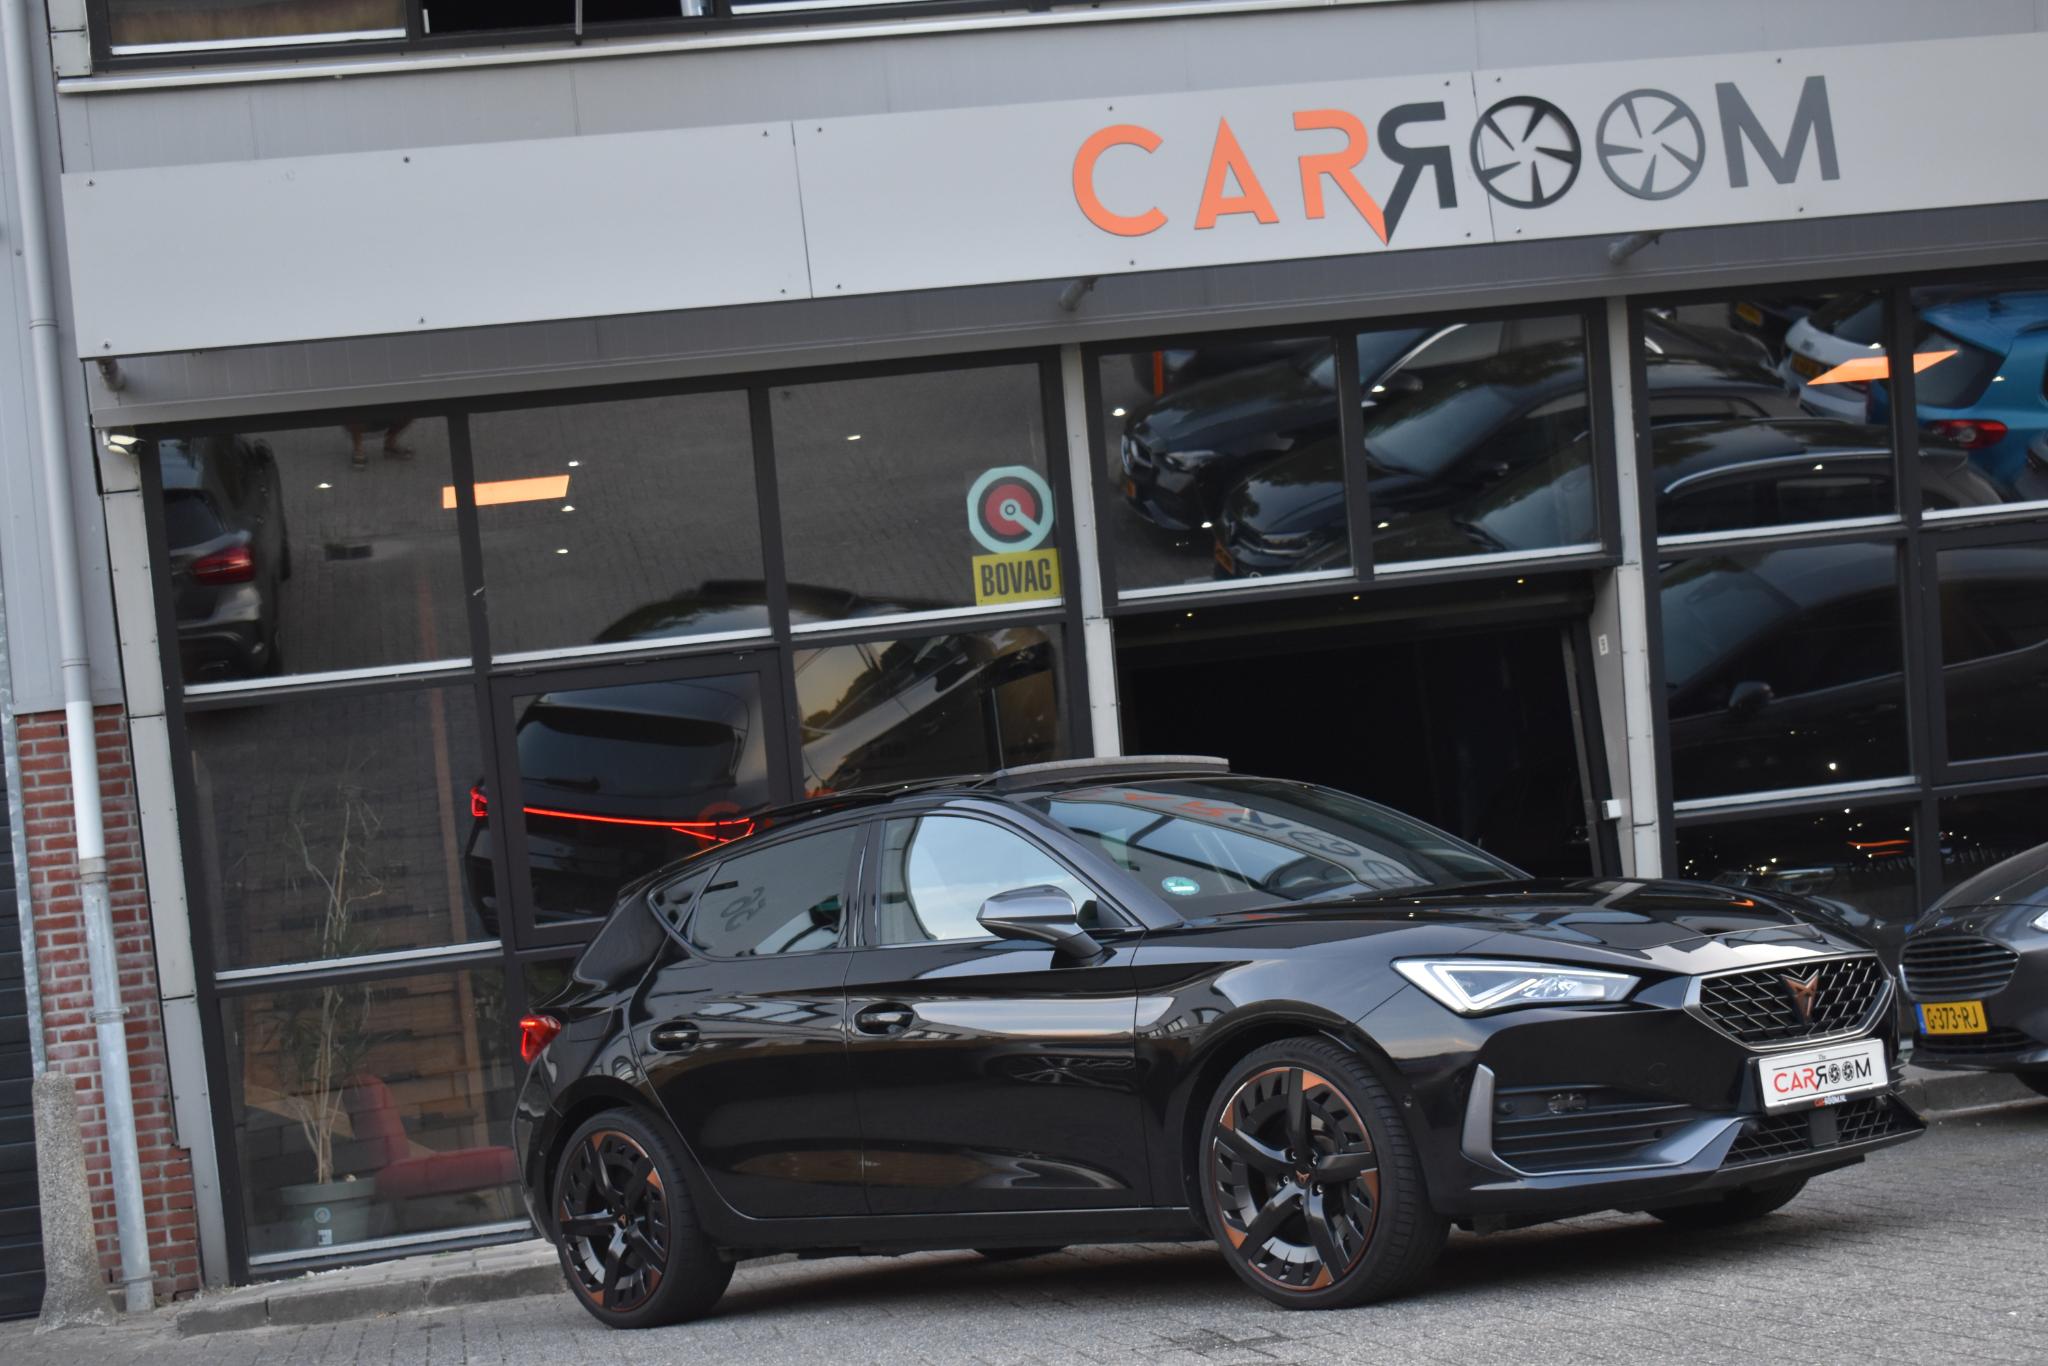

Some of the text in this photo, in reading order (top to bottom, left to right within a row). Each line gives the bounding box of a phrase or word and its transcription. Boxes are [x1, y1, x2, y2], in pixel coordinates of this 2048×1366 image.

[1073, 75, 1841, 245] CARROOM
[980, 558, 1052, 597] BOVAG
[1926, 1005, 1979, 1030] G-373-RJ
